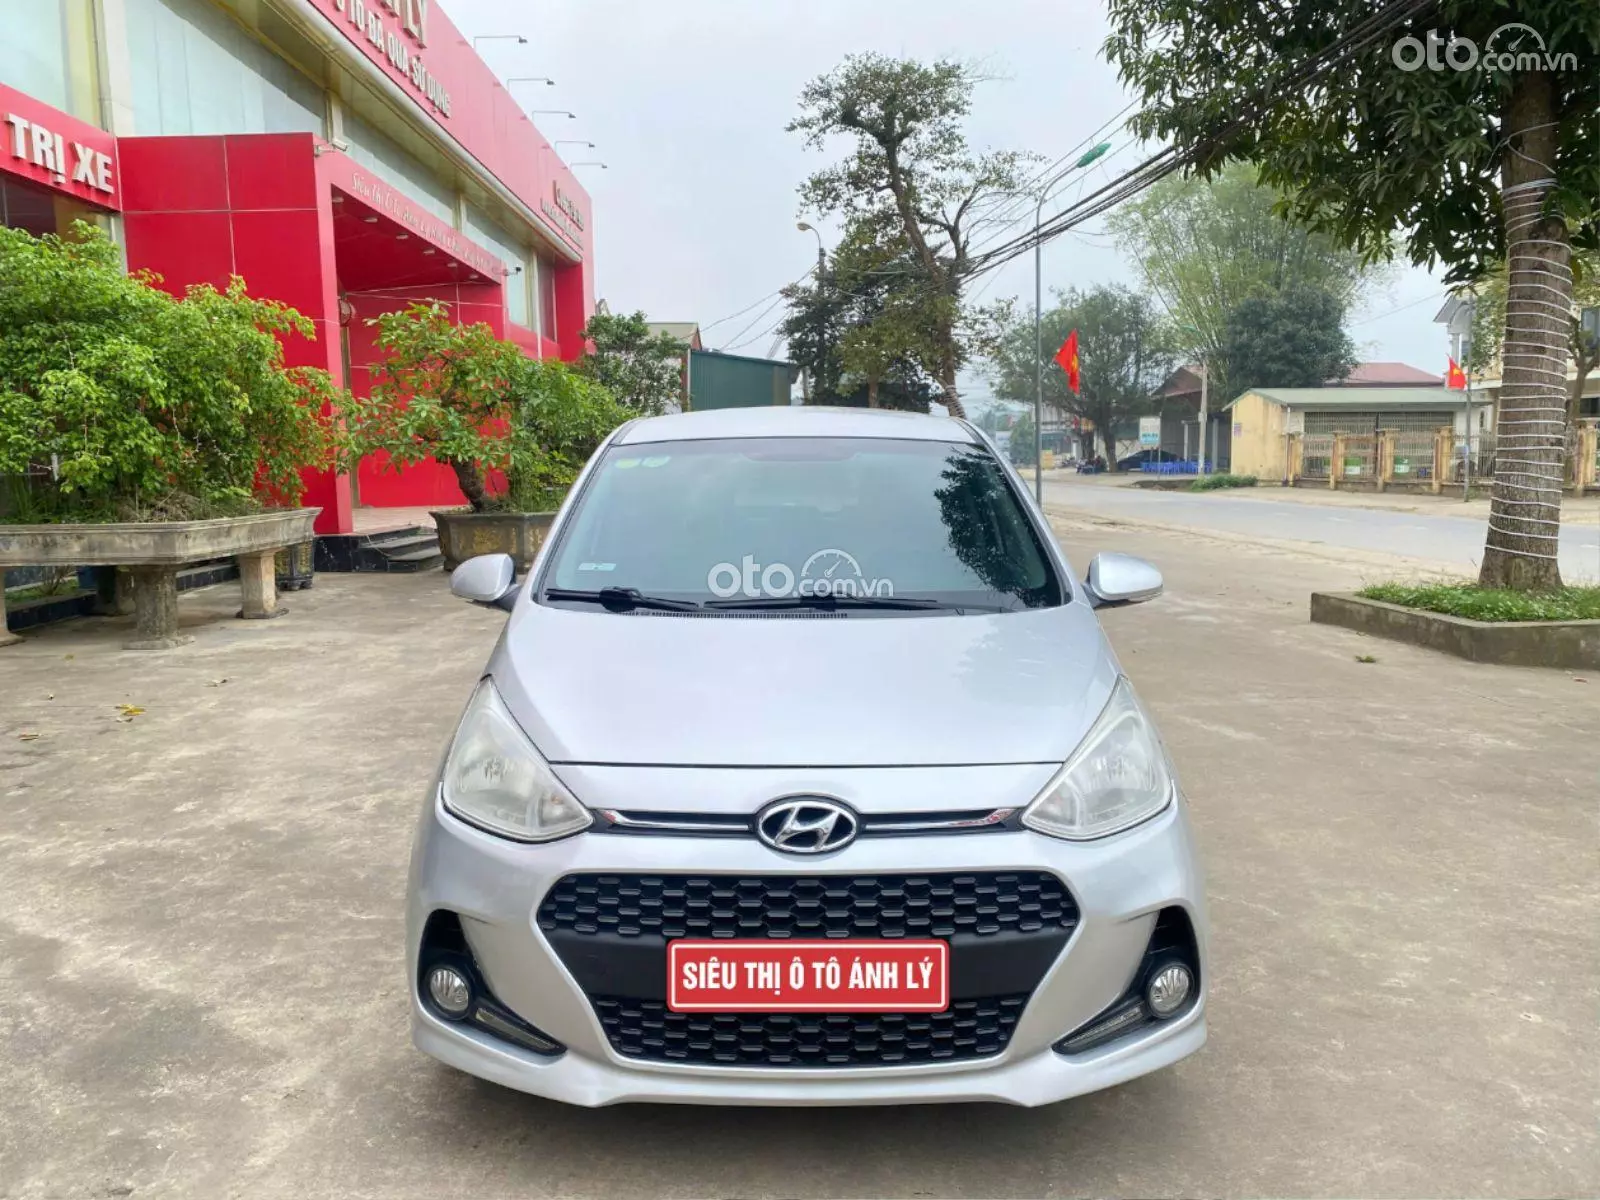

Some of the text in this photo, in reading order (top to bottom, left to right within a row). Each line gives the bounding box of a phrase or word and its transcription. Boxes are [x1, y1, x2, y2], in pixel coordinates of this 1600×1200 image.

[386, 31, 410, 78] QUA
[5, 112, 114, 194] TRỊ XE
[682, 956, 934, 996] SIÊU THỊ Ô TÔ ÁNH LÝ
